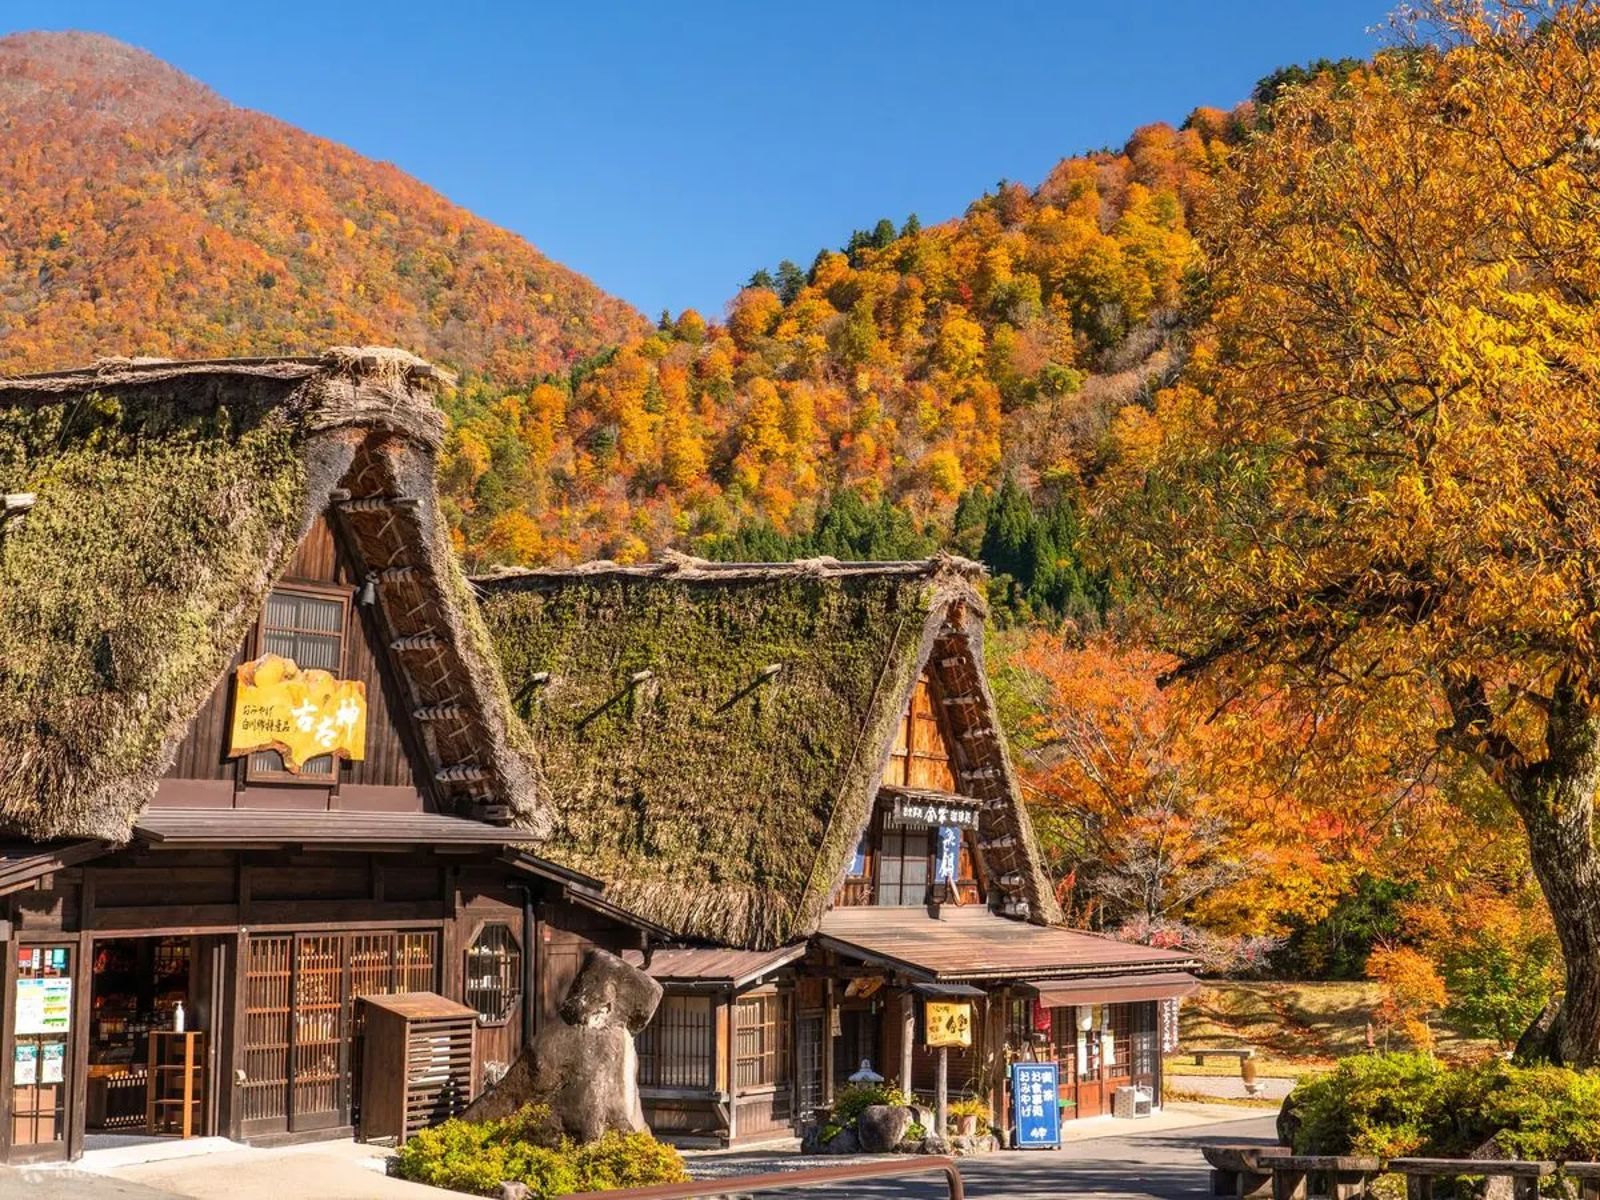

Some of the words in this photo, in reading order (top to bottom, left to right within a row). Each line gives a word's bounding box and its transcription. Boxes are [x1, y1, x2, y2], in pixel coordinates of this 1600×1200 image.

[1019, 1070, 1032, 1118] おみやげ
[1031, 1070, 1044, 1117] お食事処
